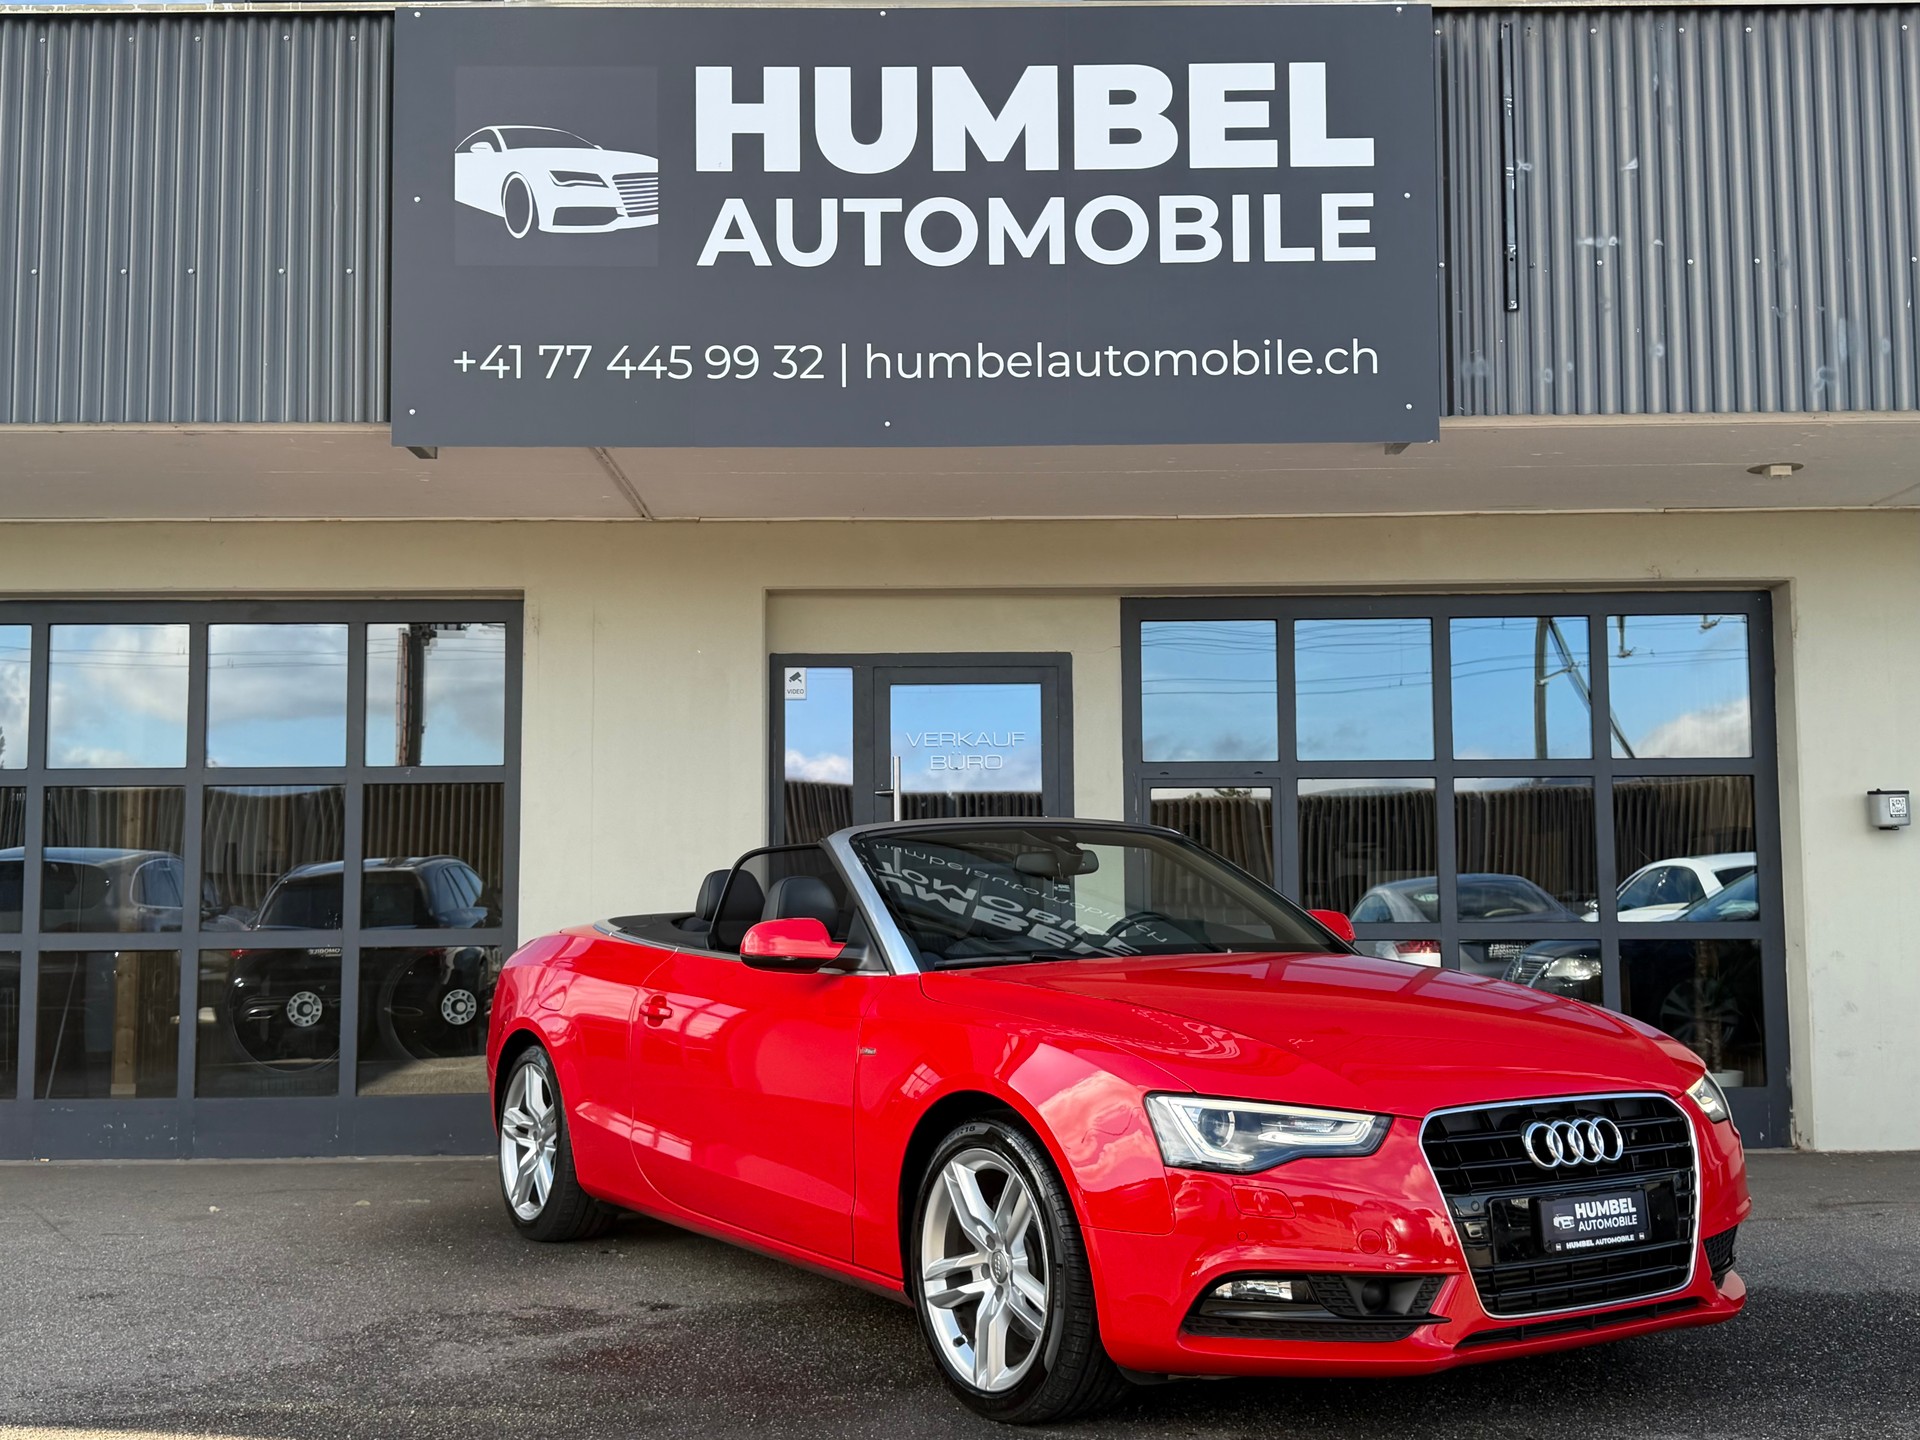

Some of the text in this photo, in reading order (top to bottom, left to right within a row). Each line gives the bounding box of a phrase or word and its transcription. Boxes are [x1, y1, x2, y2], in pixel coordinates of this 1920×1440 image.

[695, 61, 1375, 175] HUMBEL
[697, 192, 1377, 268] AUTOMOBILE
[453, 344, 522, 379] +41
[538, 344, 593, 380] 77
[606, 344, 693, 380] 445
[704, 344, 760, 380] 99
[772, 344, 825, 380] 32
[866, 337, 1378, 379] humbelautomobile.ch
[906, 731, 1026, 748] VERKAUF
[930, 751, 1004, 771] BÜRO
[1574, 1197, 1637, 1219] HUMBEL
[1578, 1214, 1638, 1232] AUTOMOBILE
[1565, 1234, 1635, 1250] HUMBEL AUTOMOBILE
